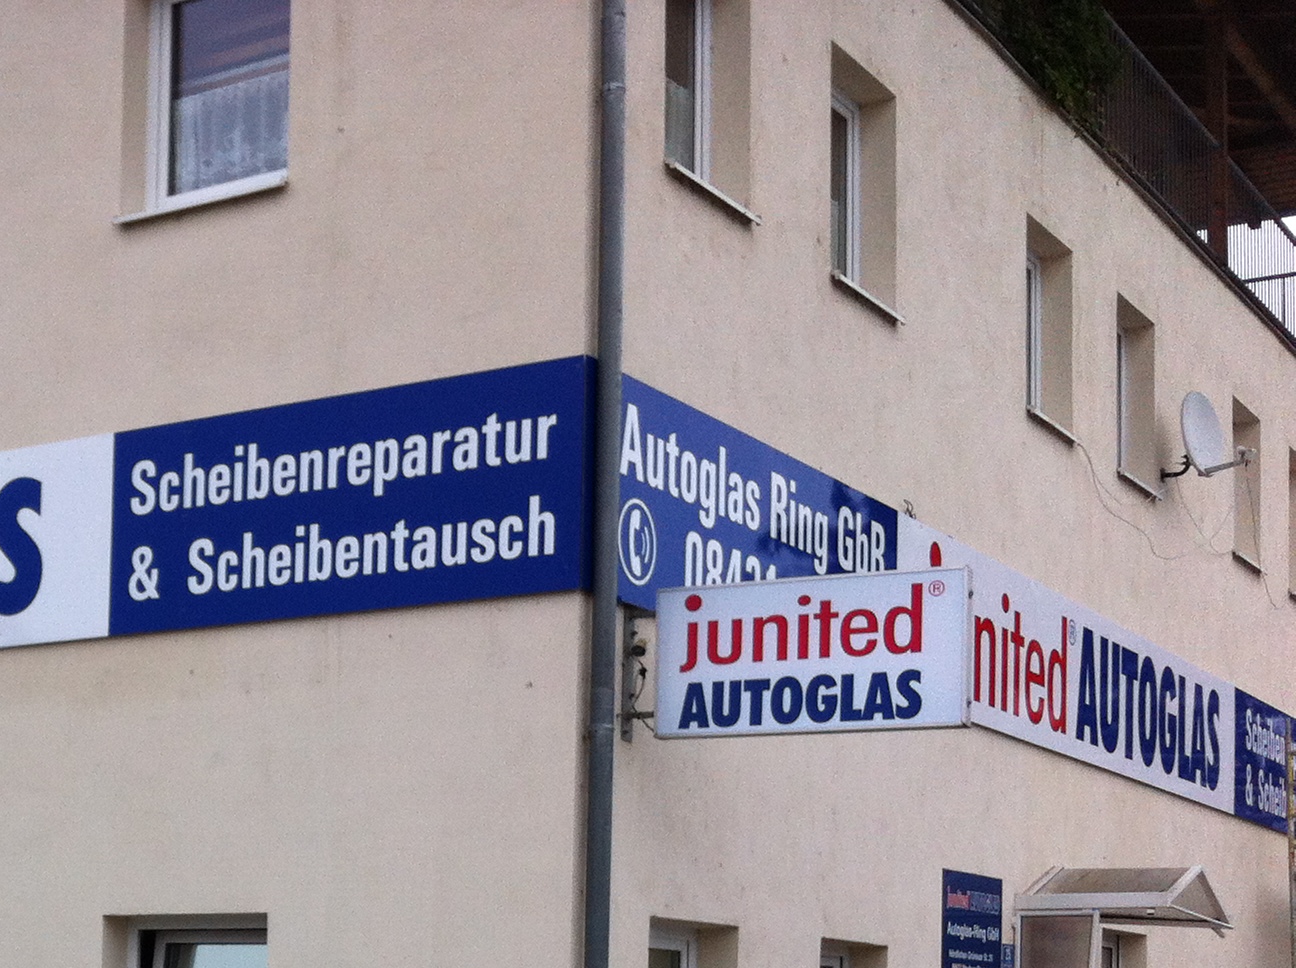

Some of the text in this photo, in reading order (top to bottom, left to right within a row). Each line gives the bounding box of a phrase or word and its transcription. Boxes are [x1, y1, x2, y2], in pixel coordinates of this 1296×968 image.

[130, 412, 557, 516] Scheibenreparatur
[619, 403, 886, 574] Autoglas Ring GbR
[128, 495, 556, 601] & Scheibentausch
[685, 531, 777, 587] 084
[679, 583, 923, 673] junited
[678, 669, 922, 729] AUTOGLAS
[1075, 626, 1220, 791] AUTOGLAS
[1245, 708, 1286, 766] Scheiben
